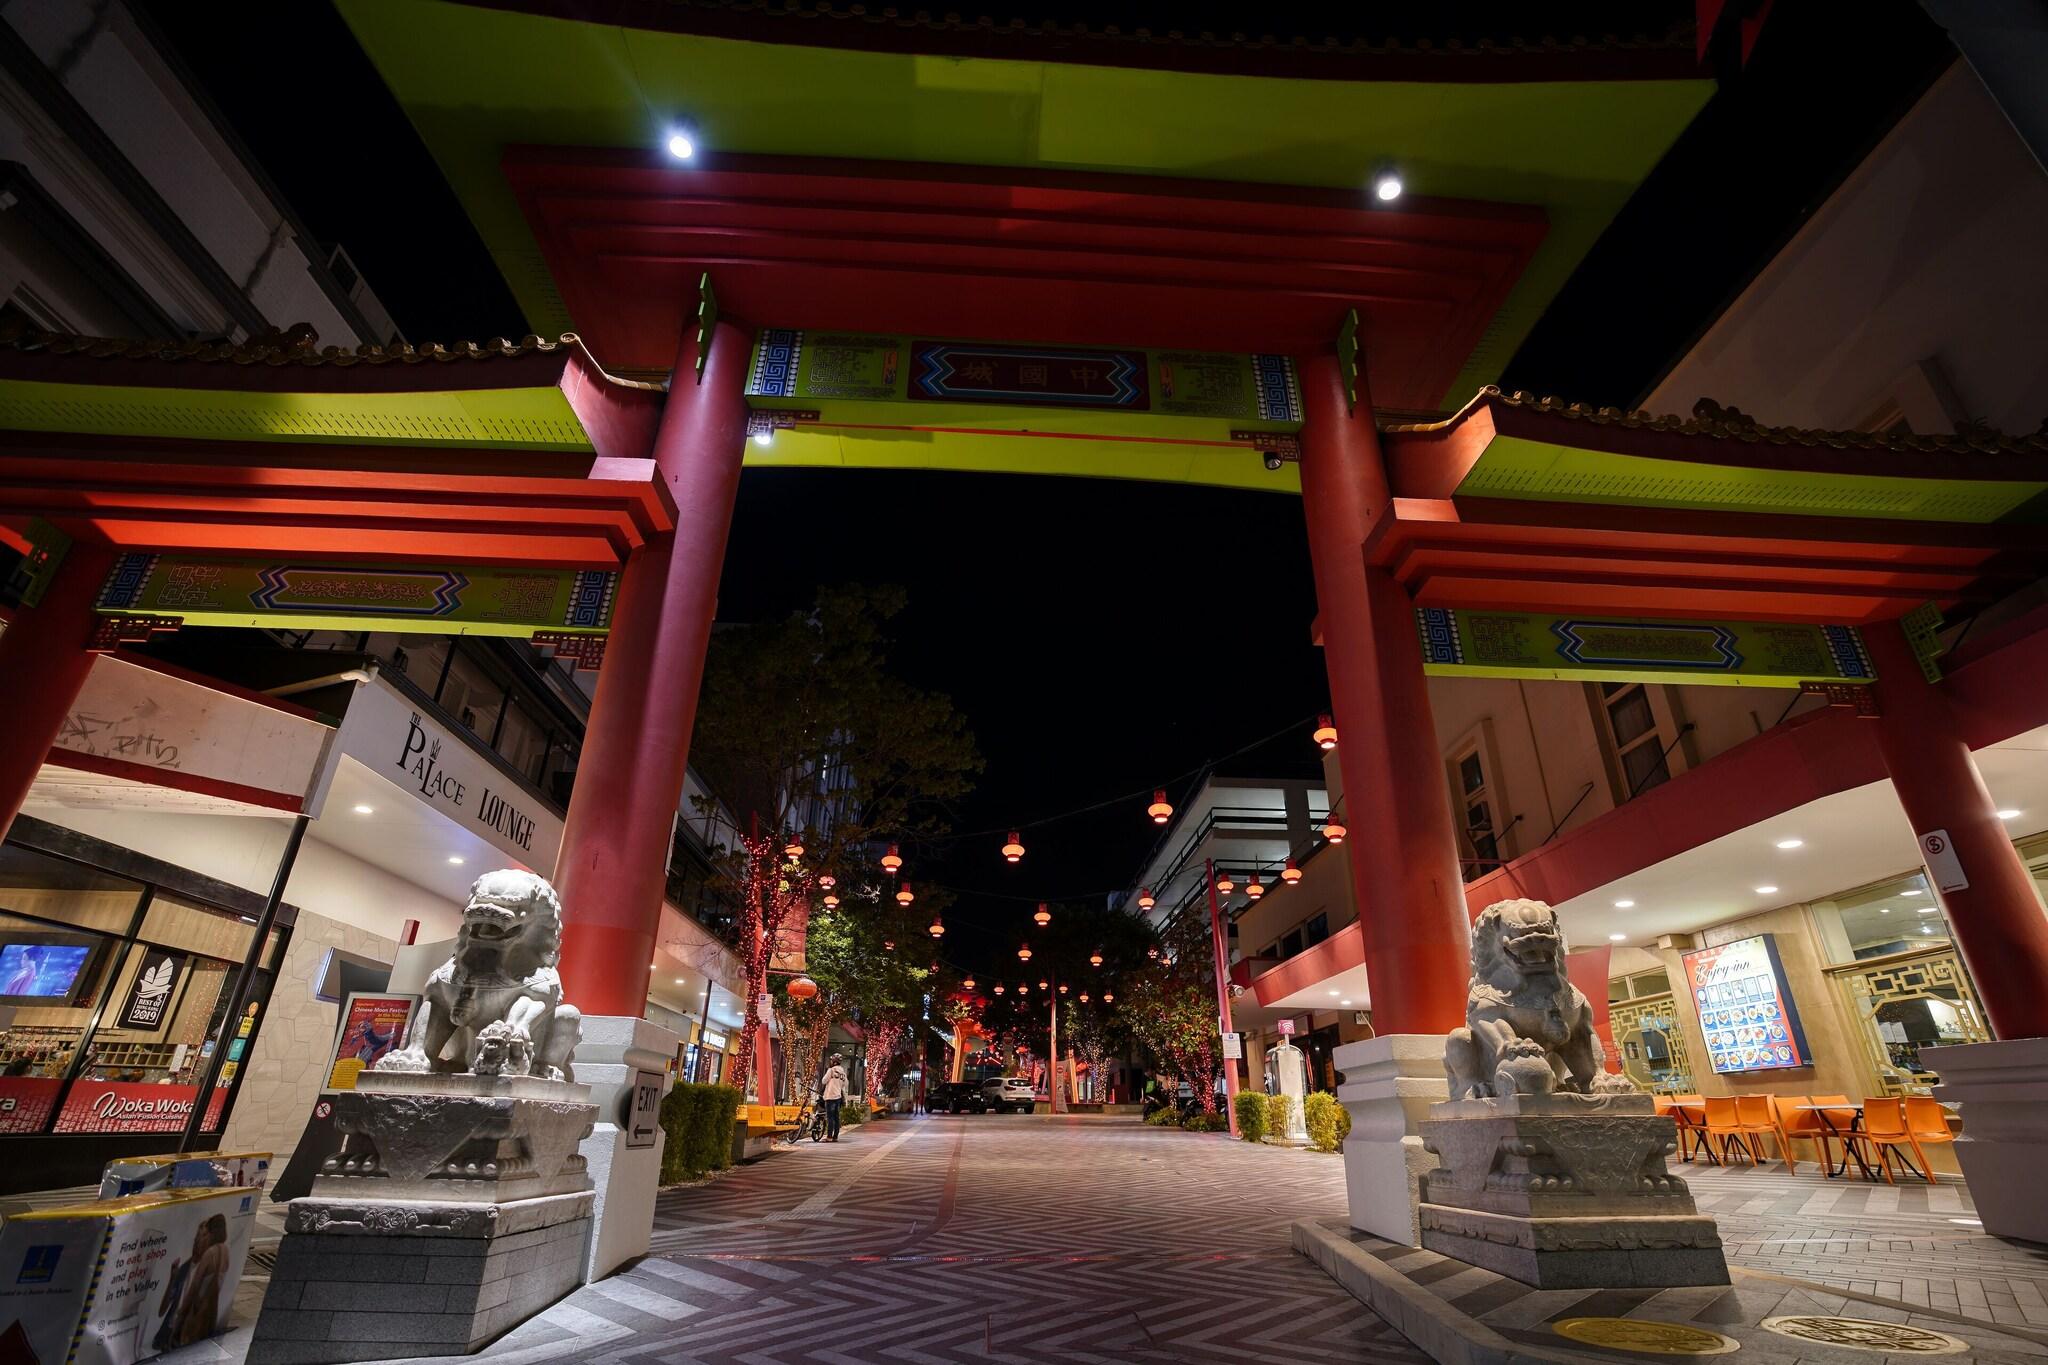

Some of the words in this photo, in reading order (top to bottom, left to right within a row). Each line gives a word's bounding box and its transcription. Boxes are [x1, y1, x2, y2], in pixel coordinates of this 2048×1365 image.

[410, 711, 422, 726] THE
[477, 787, 536, 851] LOUNGE
[138, 998, 154, 1006] BEST
[153, 1000, 161, 1008] OF
[132, 1009, 157, 1021] 2019
[93, 1091, 154, 1119] Woka
[637, 1086, 658, 1113] EXIT
[120, 1240, 138, 1253] Find
[140, 1235, 168, 1249] where
[115, 1258, 124, 1268] to
[146, 1248, 167, 1260] shop
[110, 1270, 127, 1285] and
[127, 1267, 148, 1281] play
[105, 1291, 114, 1302] in
[116, 1285, 131, 1298] the
[134, 1280, 160, 1292] Valley
